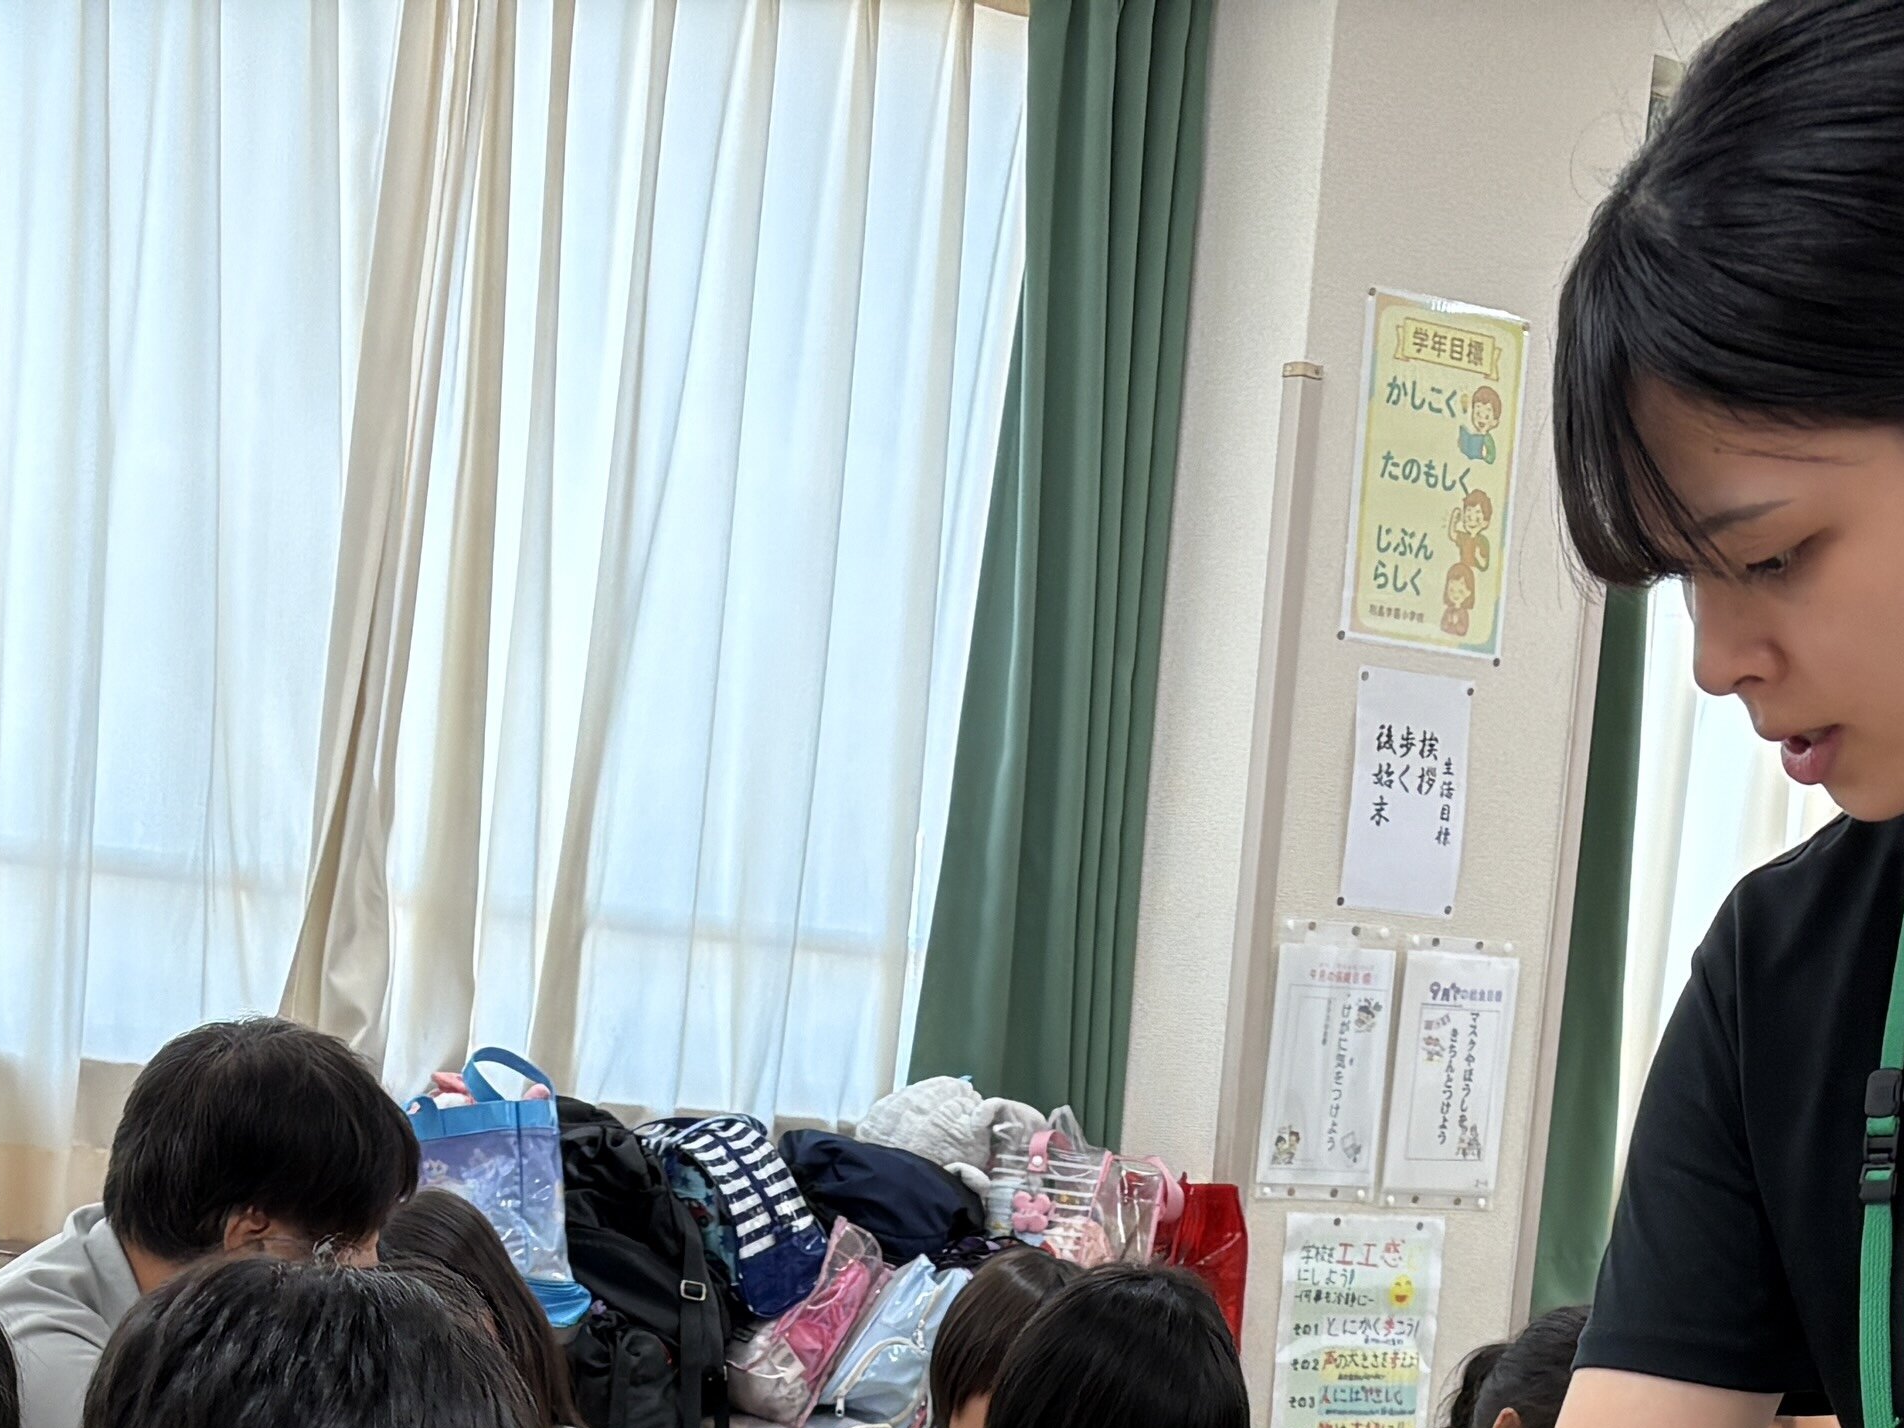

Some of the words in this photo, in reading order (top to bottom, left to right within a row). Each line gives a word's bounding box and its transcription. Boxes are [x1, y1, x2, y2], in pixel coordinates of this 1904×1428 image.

[1411, 327, 1485, 366] 学年目標
[1384, 374, 1457, 418] かしこく
[1379, 449, 1471, 495] たのもしく
[1376, 523, 1435, 562] じぶん
[1372, 559, 1421, 595] らしく
[1369, 721, 1398, 828] 後始末
[1397, 724, 1416, 793] 歩く
